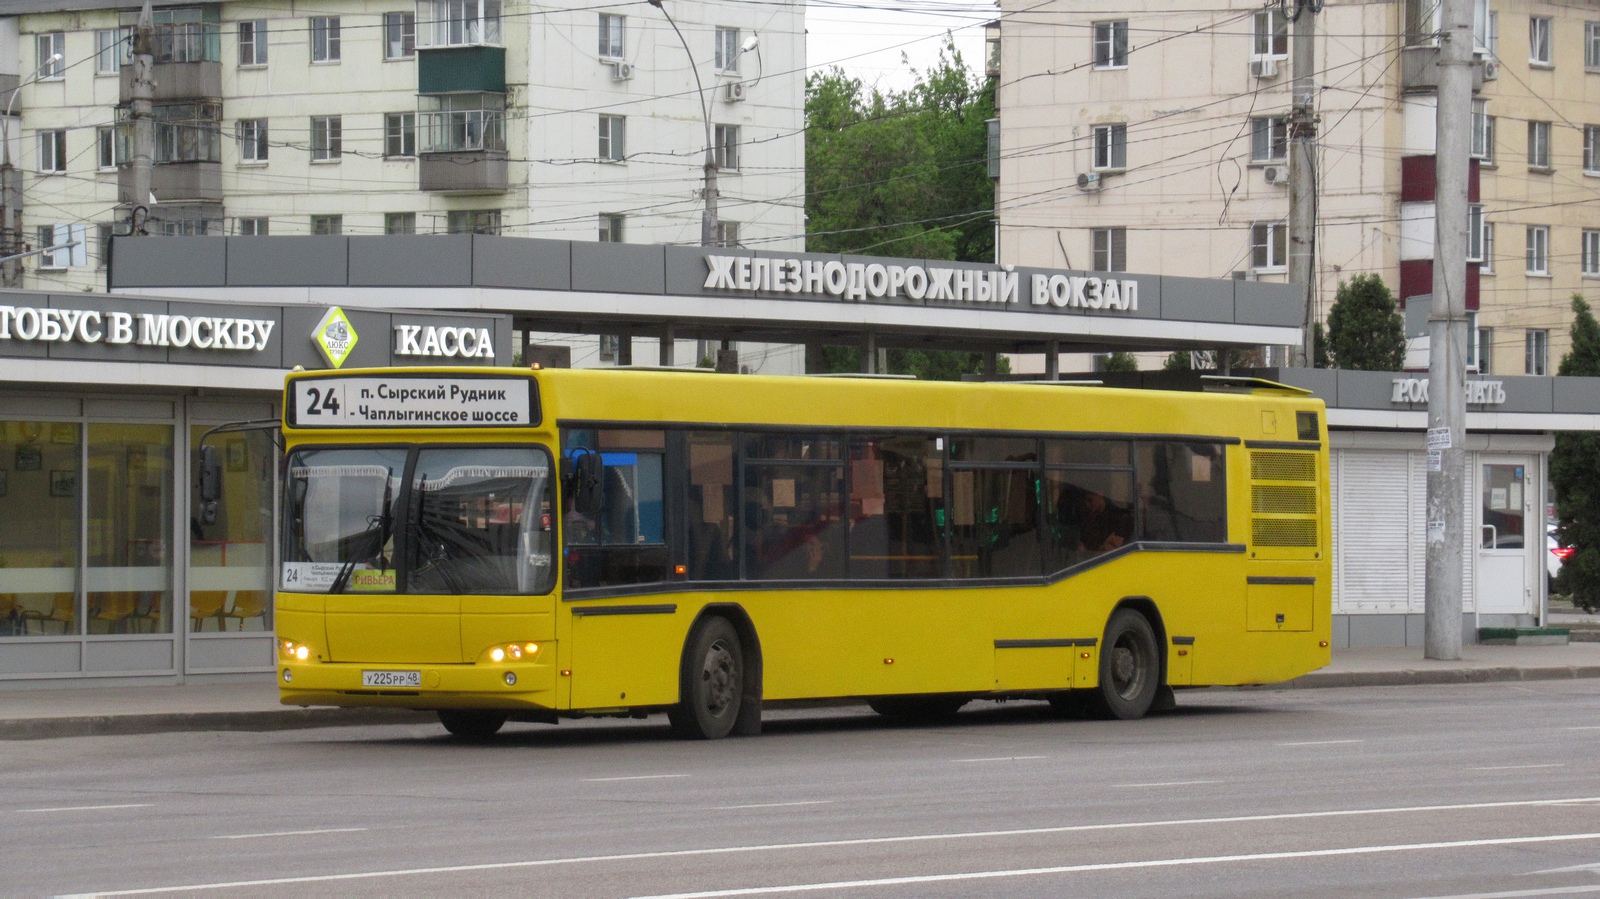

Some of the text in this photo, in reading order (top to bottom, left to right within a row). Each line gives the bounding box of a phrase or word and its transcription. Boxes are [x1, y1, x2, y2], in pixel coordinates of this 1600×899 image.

[703, 254, 1139, 310] ЖЕЛЕЗНОДОРОЖНЫЙ ВОКЗАЛ
[107, 311, 133, 344] В
[137, 313, 275, 351] МОСКВУ
[326, 341, 349, 349] ЛЮКС
[394, 325, 495, 358] КАССА
[306, 387, 340, 416] 24
[361, 384, 506, 403] п. Сырский Рудник
[358, 405, 469, 422] Чаплыгинское
[472, 409, 519, 422] шоссе
[286, 568, 298, 582] 24
[355, 575, 394, 586] РИВЬЕРА
